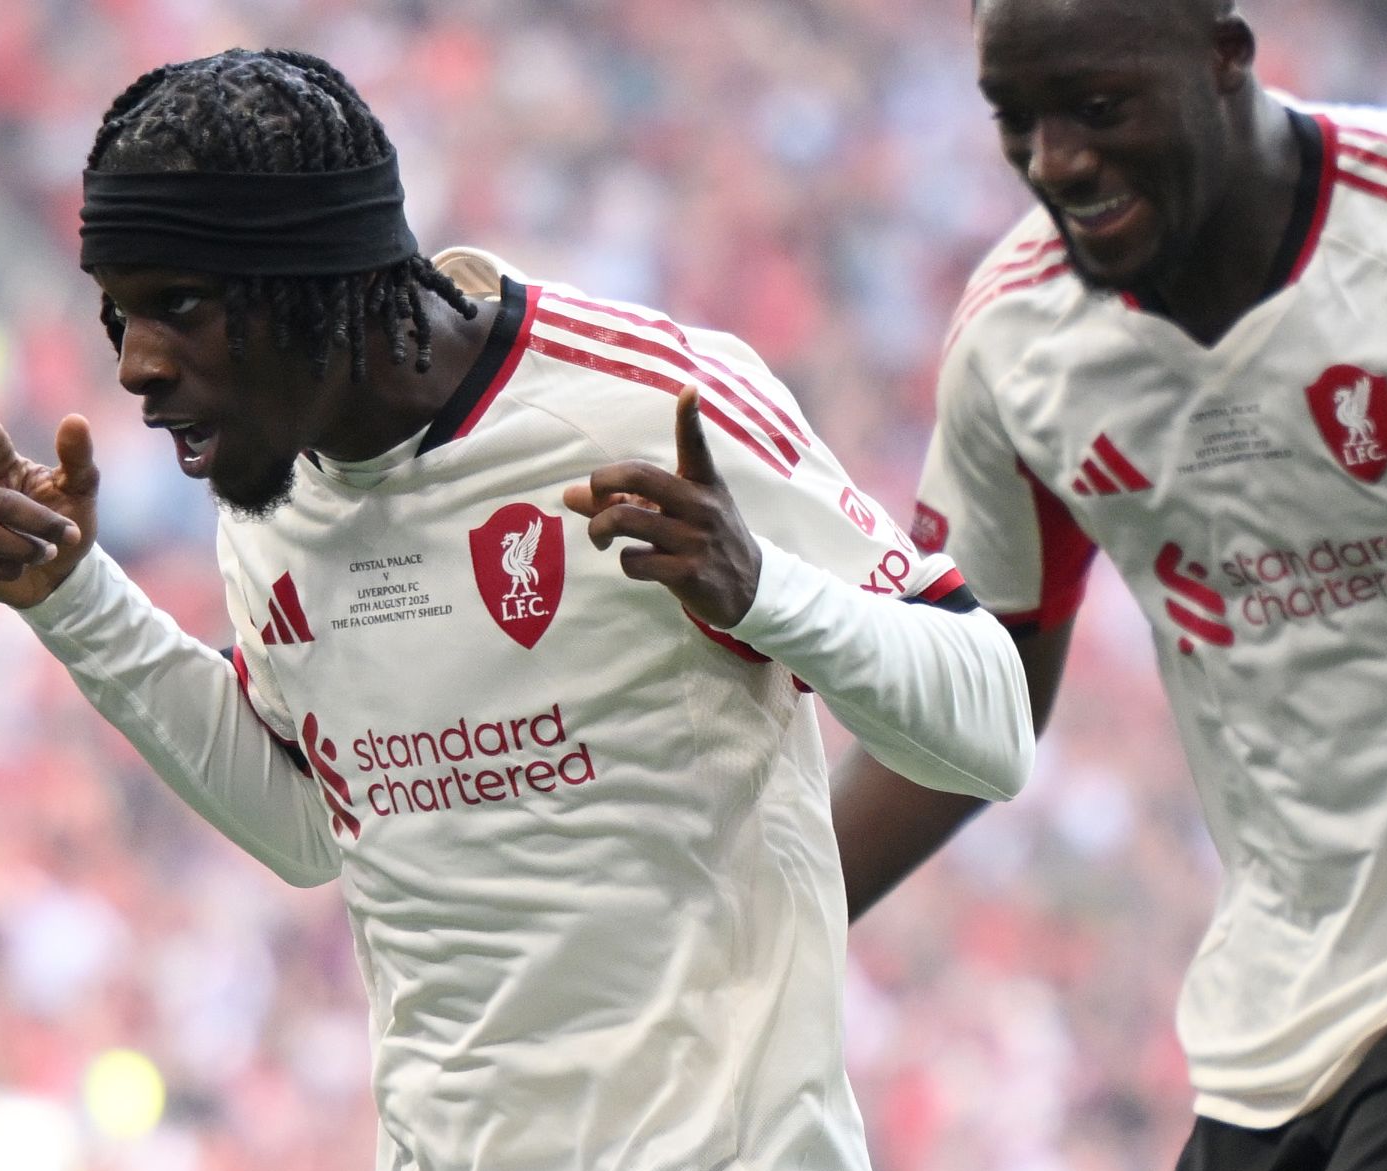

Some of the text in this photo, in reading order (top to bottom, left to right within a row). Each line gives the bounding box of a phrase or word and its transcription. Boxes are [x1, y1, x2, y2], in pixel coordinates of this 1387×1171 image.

[349, 553, 423, 573] CRYSTAL PALACE
[357, 581, 420, 600] LIVERPOOL FC
[349, 594, 430, 614] 10TH AUGUST 2025
[501, 597, 550, 621] L.F.C.
[331, 604, 453, 631] THE FA COMMUNITY SHIELD
[353, 702, 567, 772] standard
[367, 742, 596, 816] chartered
